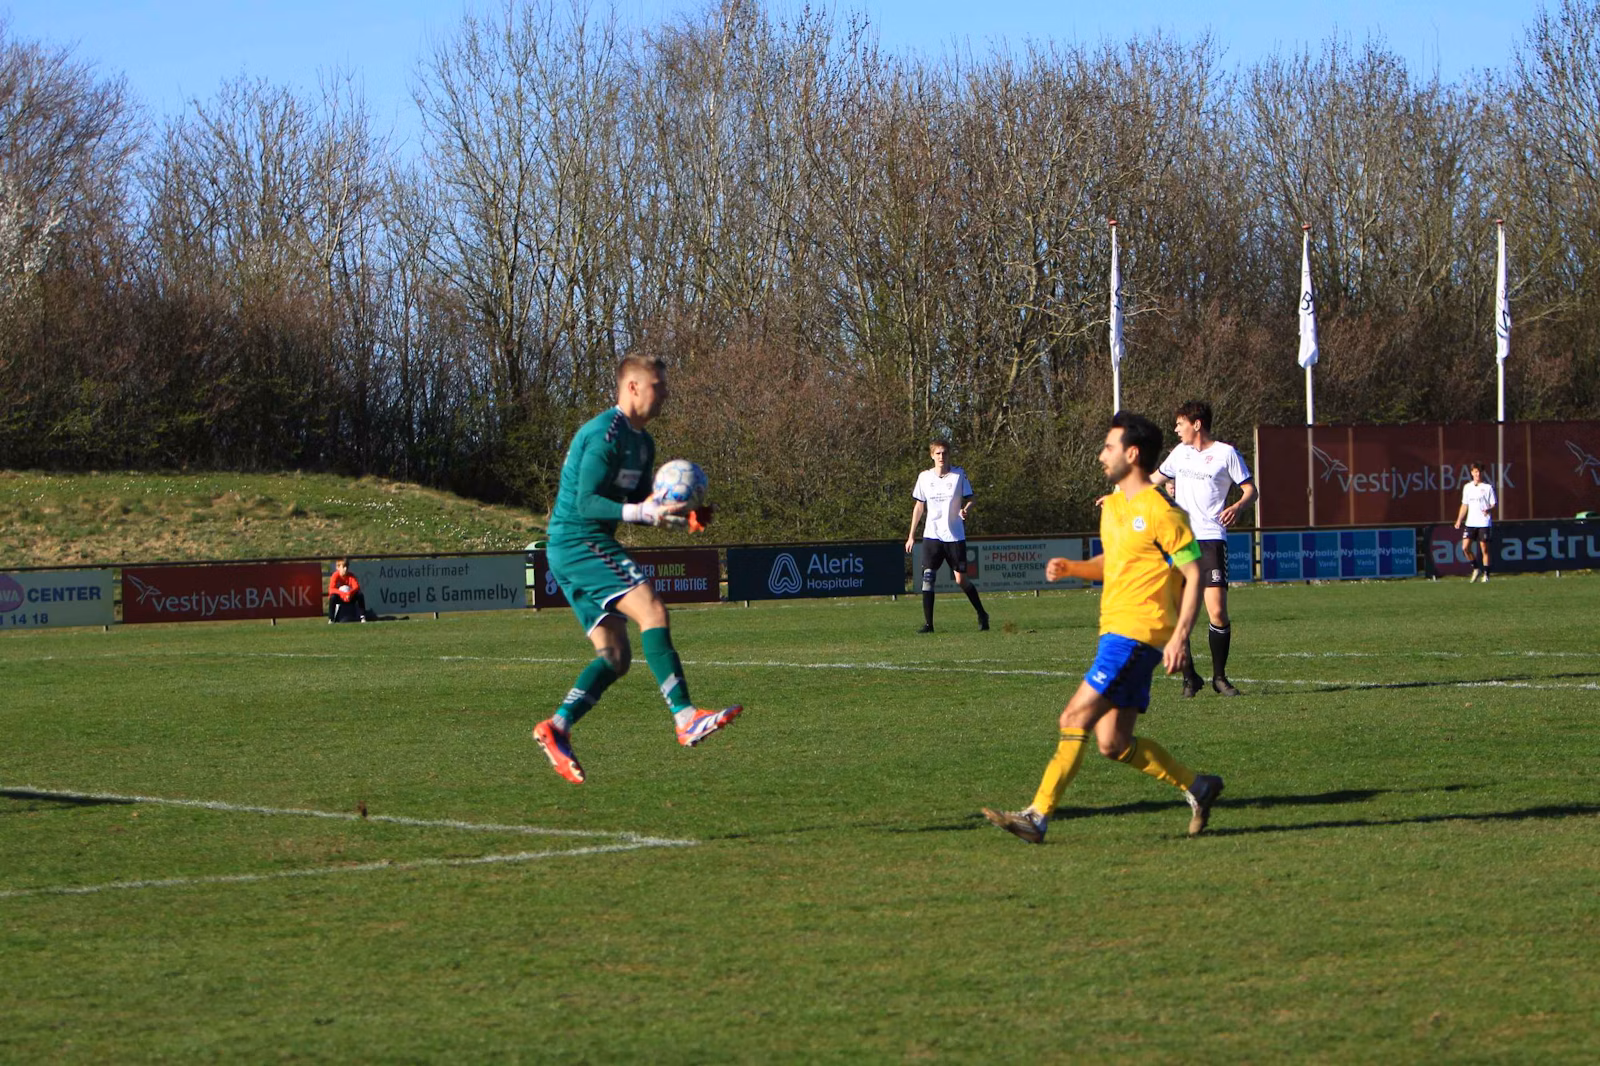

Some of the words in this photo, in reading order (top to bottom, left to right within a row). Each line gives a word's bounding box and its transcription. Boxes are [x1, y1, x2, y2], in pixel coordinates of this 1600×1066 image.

[1264, 550, 1300, 560] Nybolig
[1303, 548, 1339, 559] Nybolig
[1341, 547, 1377, 558] Nybolig
[1379, 546, 1415, 557] Nybolig
[379, 562, 470, 578] Advokatfirmaet
[658, 563, 686, 577] VARDE
[807, 553, 864, 575] Aleris
[1011, 562, 1045, 571] IVERSEN
[655, 578, 671, 593] DET
[674, 577, 708, 592] RIGTIGE
[807, 577, 865, 591] Hospitaler
[27, 586, 101, 603] CENTER
[153, 585, 313, 617] vestjyskBANK
[380, 586, 421, 608] Vogel
[426, 586, 438, 602] &
[441, 584, 518, 604] Gammelby
[11, 613, 27, 625] 14
[33, 613, 49, 624] 18
